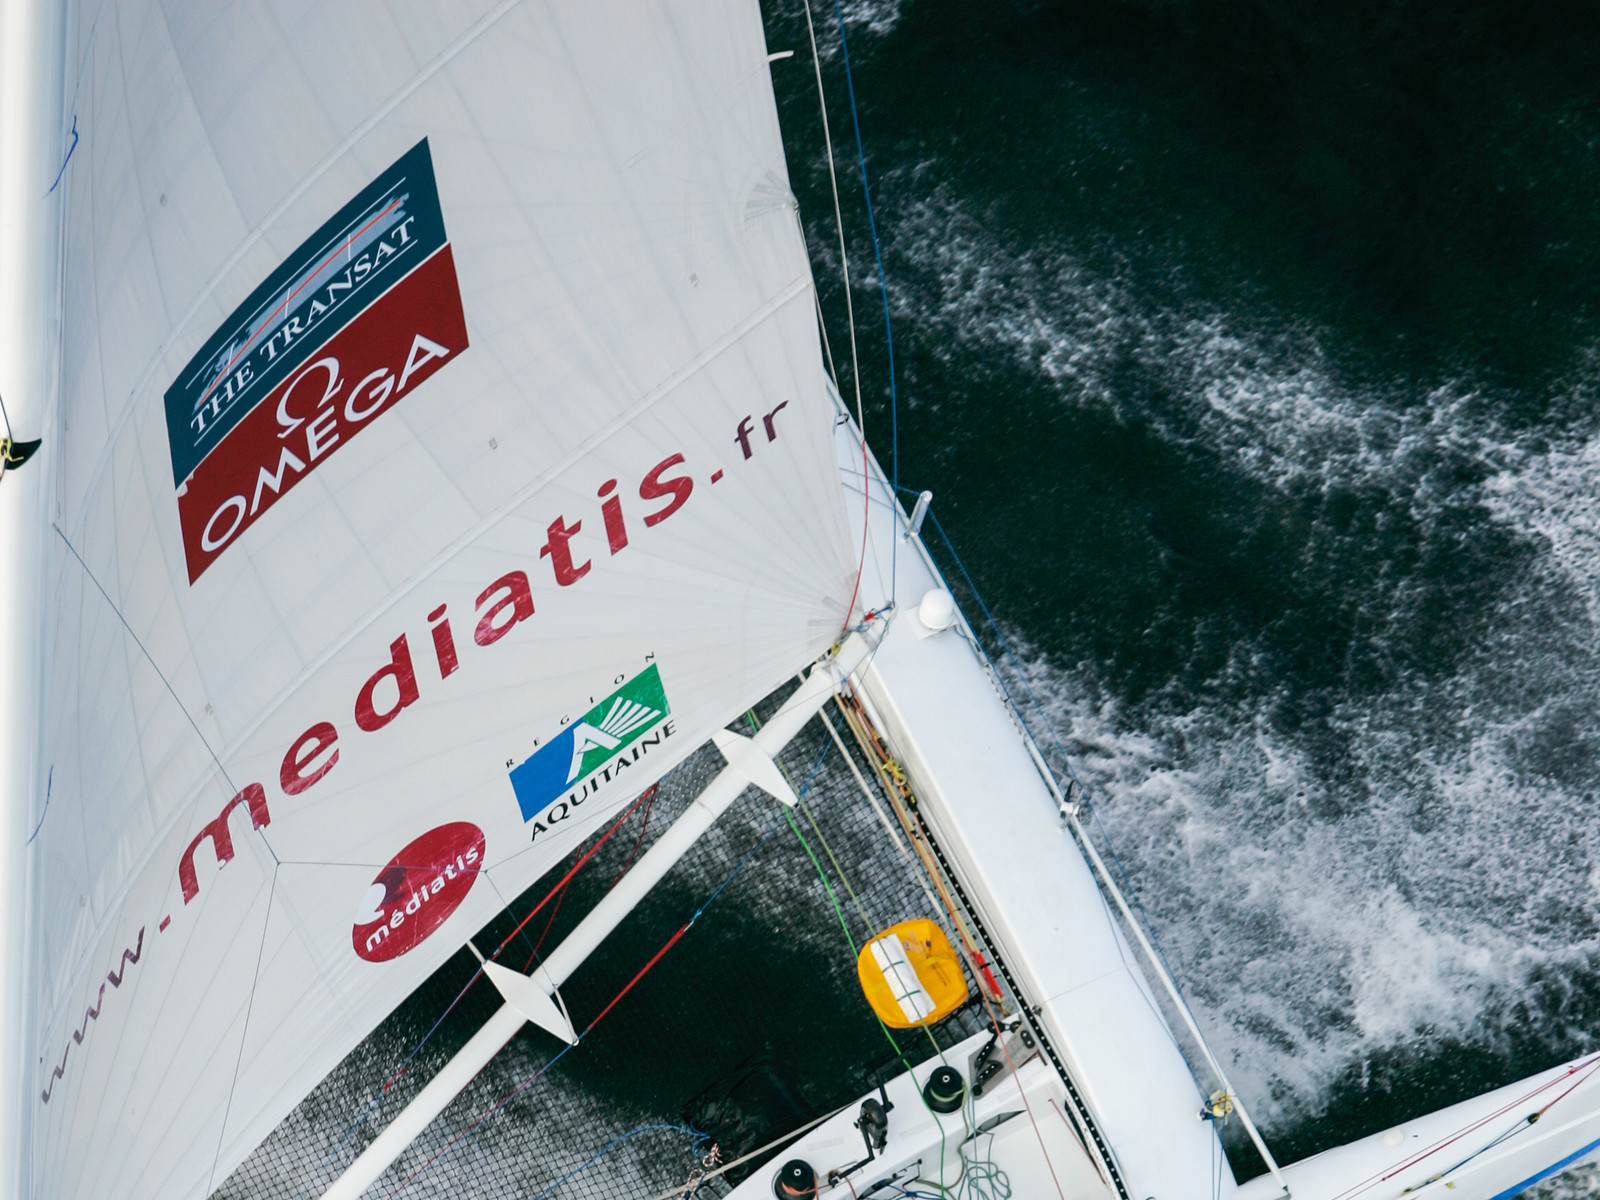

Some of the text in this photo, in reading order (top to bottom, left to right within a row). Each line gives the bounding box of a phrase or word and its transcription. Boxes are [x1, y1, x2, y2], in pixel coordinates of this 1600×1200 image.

[190, 216, 415, 434] THE TRANSAT
[201, 333, 450, 553] OMEGA
[41, 400, 789, 1105] www.mediatis.fr
[531, 719, 677, 842] AQUITAINE
[365, 846, 479, 952] médiatis
